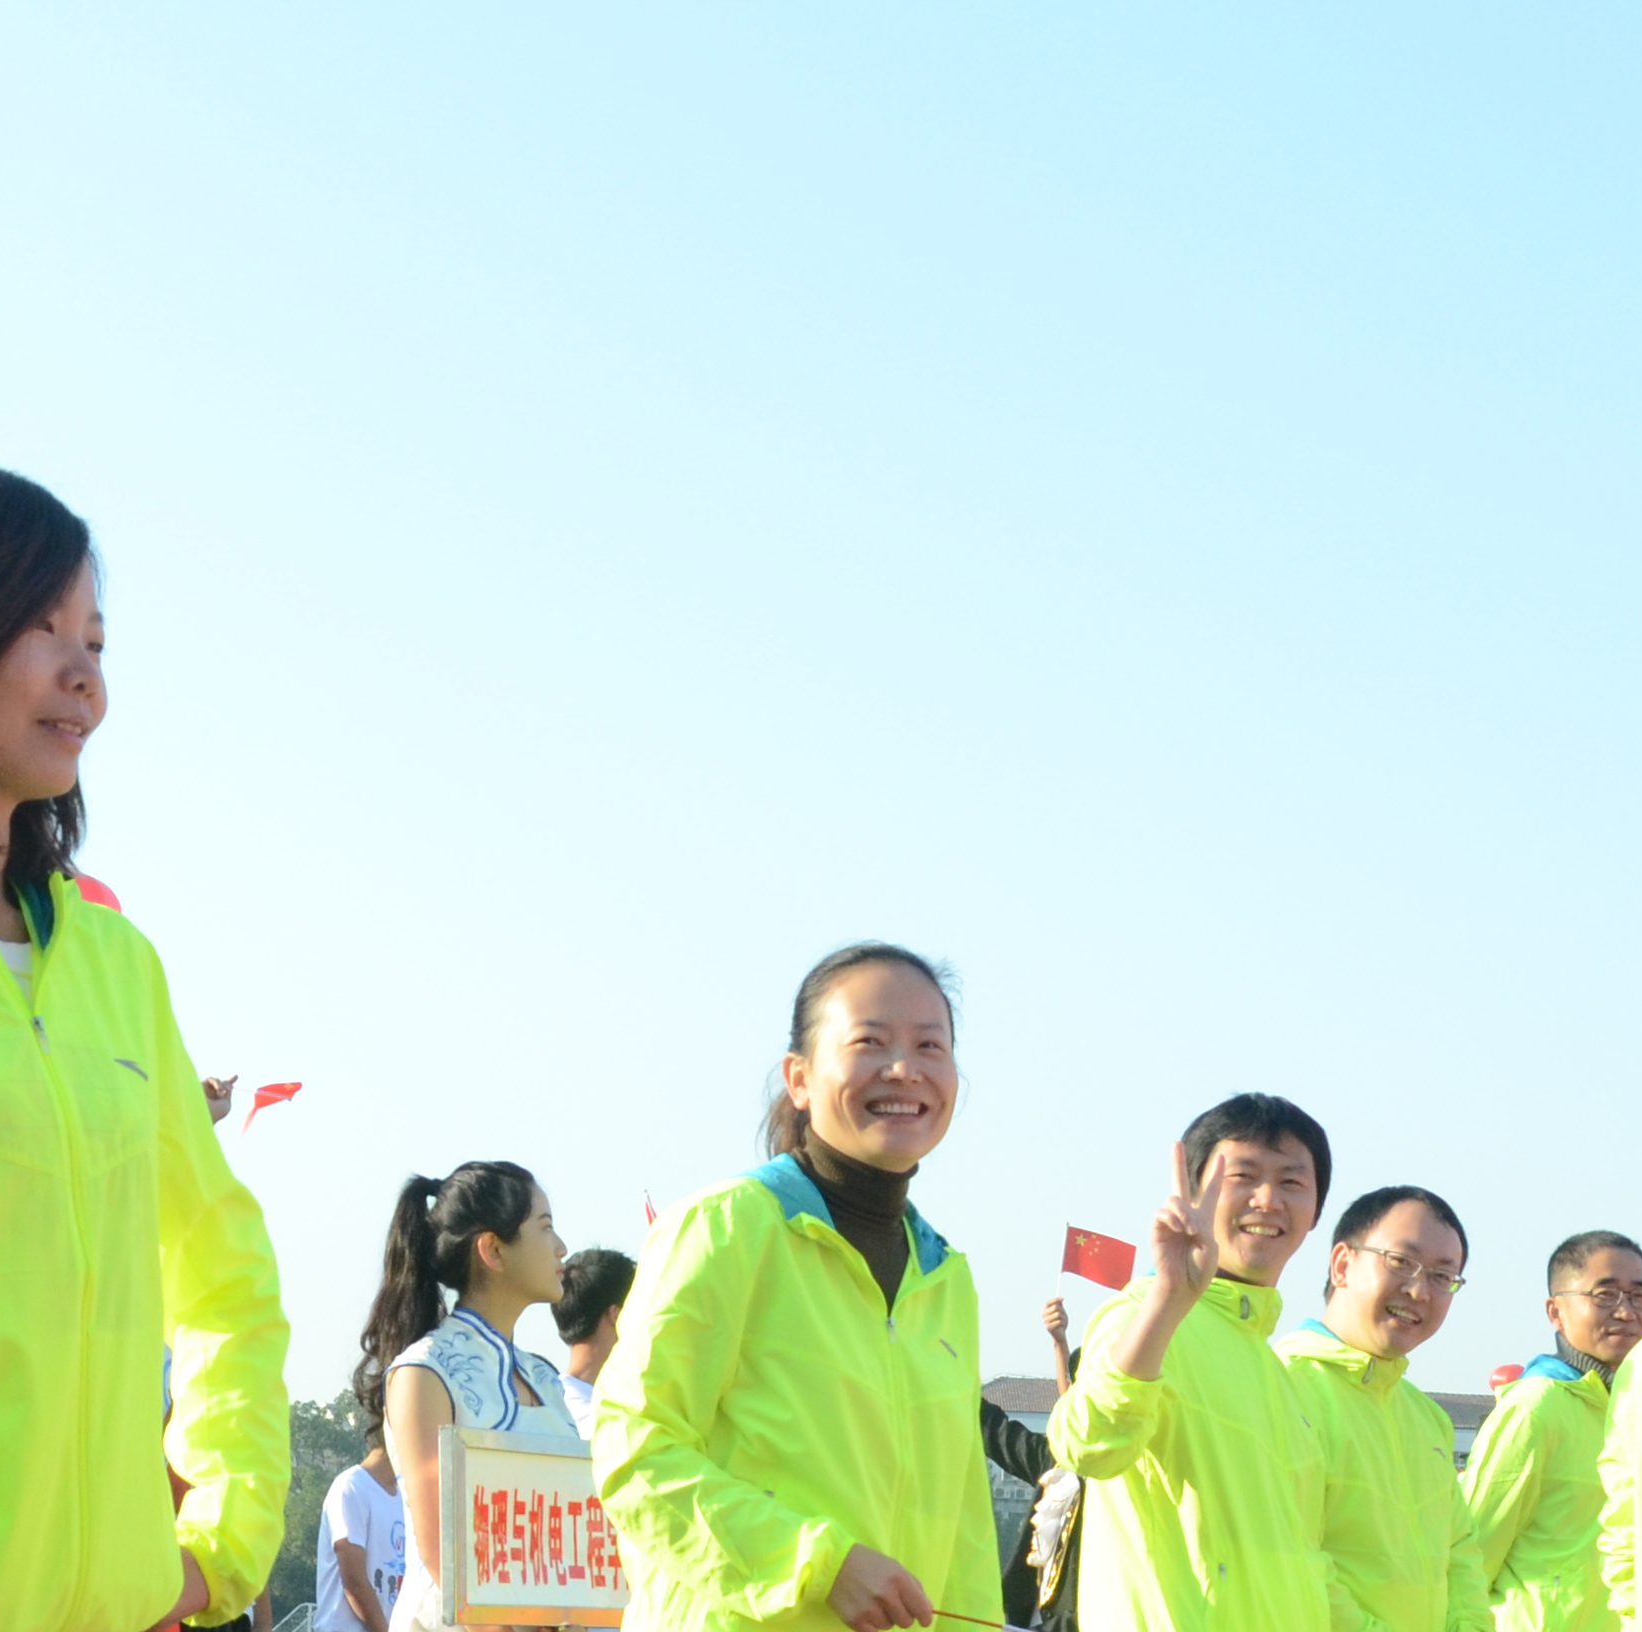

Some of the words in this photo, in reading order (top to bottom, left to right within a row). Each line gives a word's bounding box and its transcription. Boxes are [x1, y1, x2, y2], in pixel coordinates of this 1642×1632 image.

[473, 1484, 629, 1591] 物理与机电工程学
